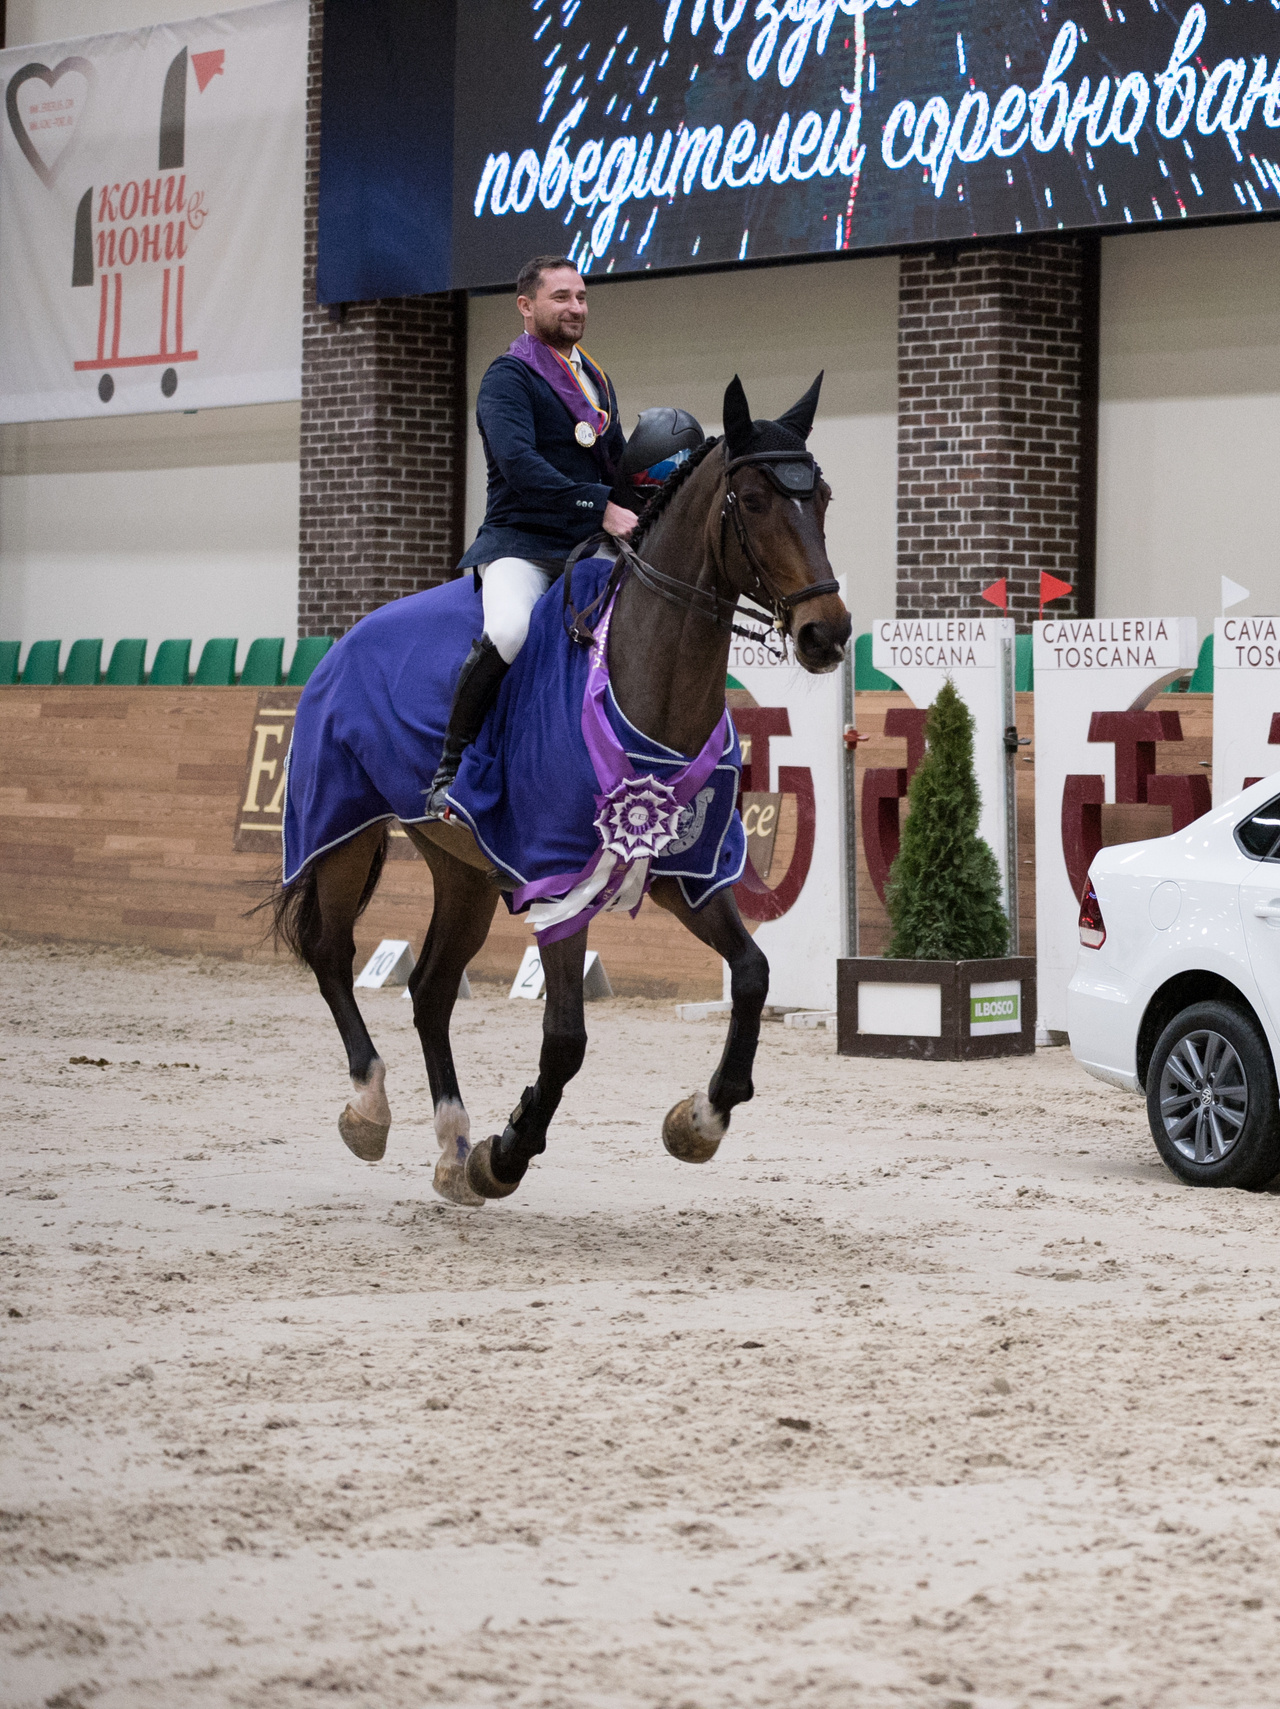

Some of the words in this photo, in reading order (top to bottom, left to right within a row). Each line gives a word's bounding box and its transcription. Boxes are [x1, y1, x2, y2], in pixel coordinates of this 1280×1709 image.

[474, 86, 867, 257] победителей
[880, 622, 987, 643] CAVALLERIA
[1042, 619, 1169, 644] CAVALLERIA
[890, 646, 977, 666] TOSCANA
[1054, 646, 1157, 669] TOSCANA
[373, 951, 396, 978] 10
[521, 958, 541, 988] 2
